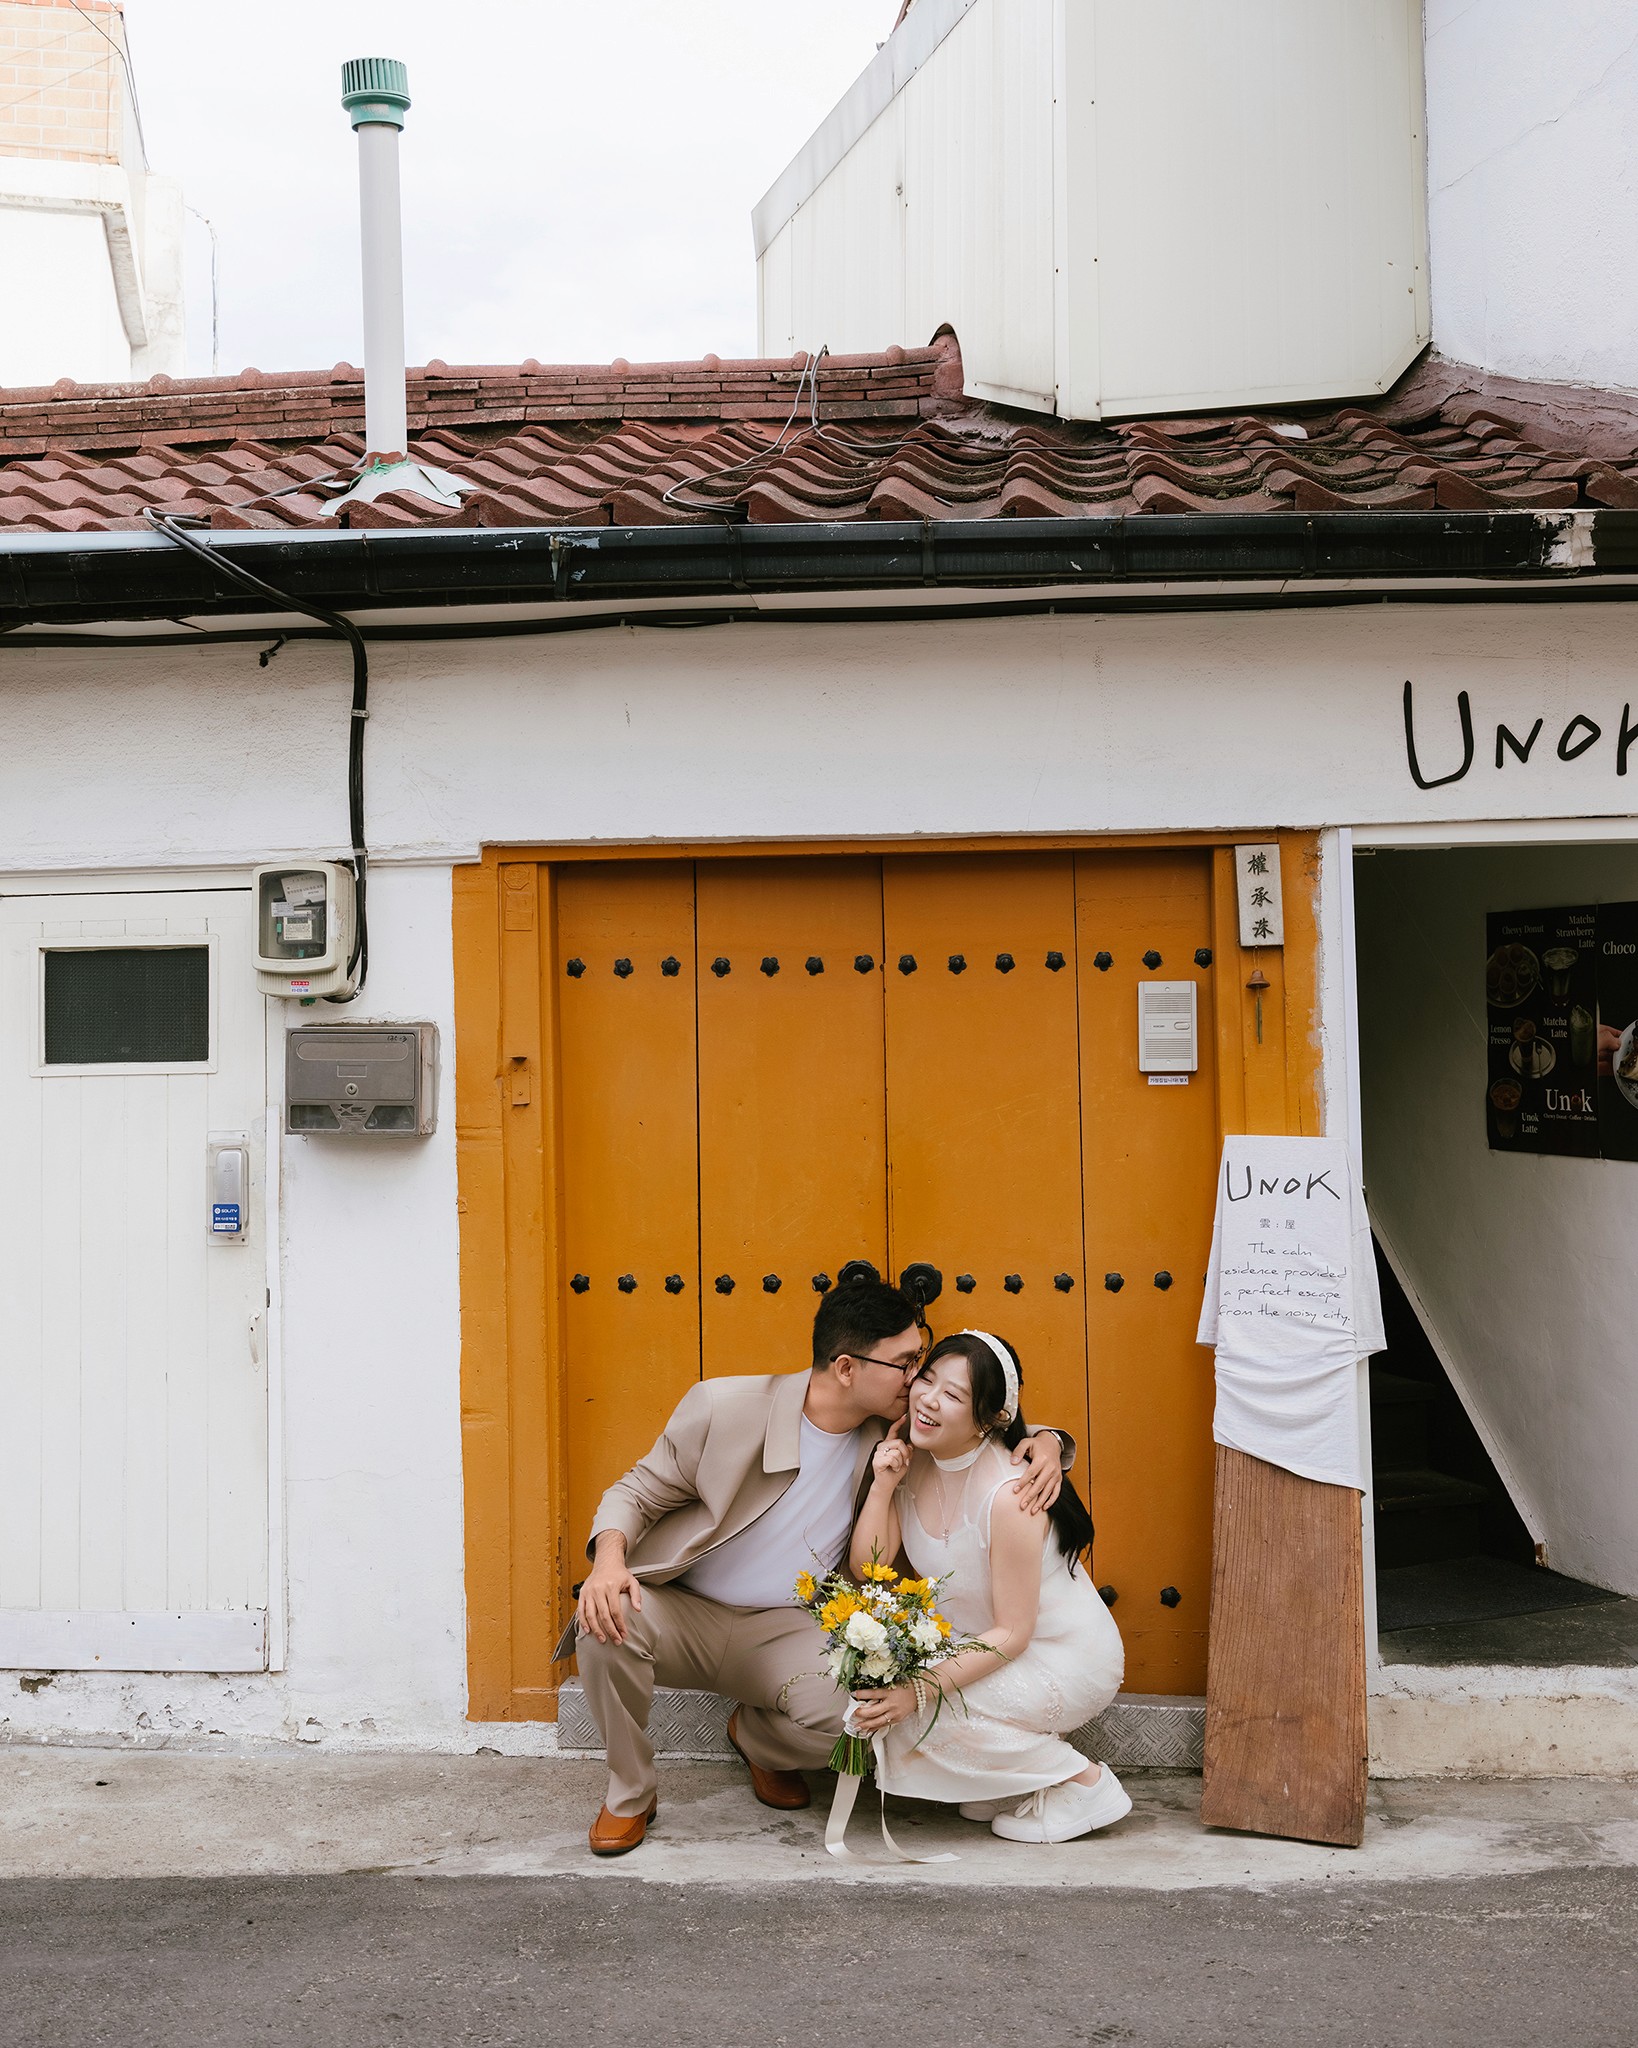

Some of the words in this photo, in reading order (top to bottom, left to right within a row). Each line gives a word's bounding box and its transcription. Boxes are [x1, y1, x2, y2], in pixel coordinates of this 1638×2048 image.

[1568, 914, 1596, 925] Matcha
[1502, 925, 1523, 937] Chewy
[1524, 924, 1545, 934] Donut
[1555, 927, 1596, 938] Strawberry
[1578, 938, 1596, 948] Latte
[1602, 940, 1636, 955] Choco
[1543, 1016, 1567, 1027] Matcha
[1490, 1024, 1512, 1034] Lemon
[1551, 1029, 1568, 1038] Latte
[1490, 1036, 1511, 1045] Presso
[1521, 1112, 1540, 1122] Unok
[1521, 1124, 1539, 1134] Latte
[1248, 1241, 1276, 1255] The
[1282, 1243, 1312, 1256] calm
[1284, 1265, 1347, 1280] provided
[1238, 1283, 1291, 1300] perfect
[1298, 1291, 1341, 1303] escape
[1218, 1304, 1253, 1316] from
[1258, 1303, 1280, 1317] the
[1285, 1309, 1317, 1324] noisy
[1323, 1307, 1350, 1326] city.
